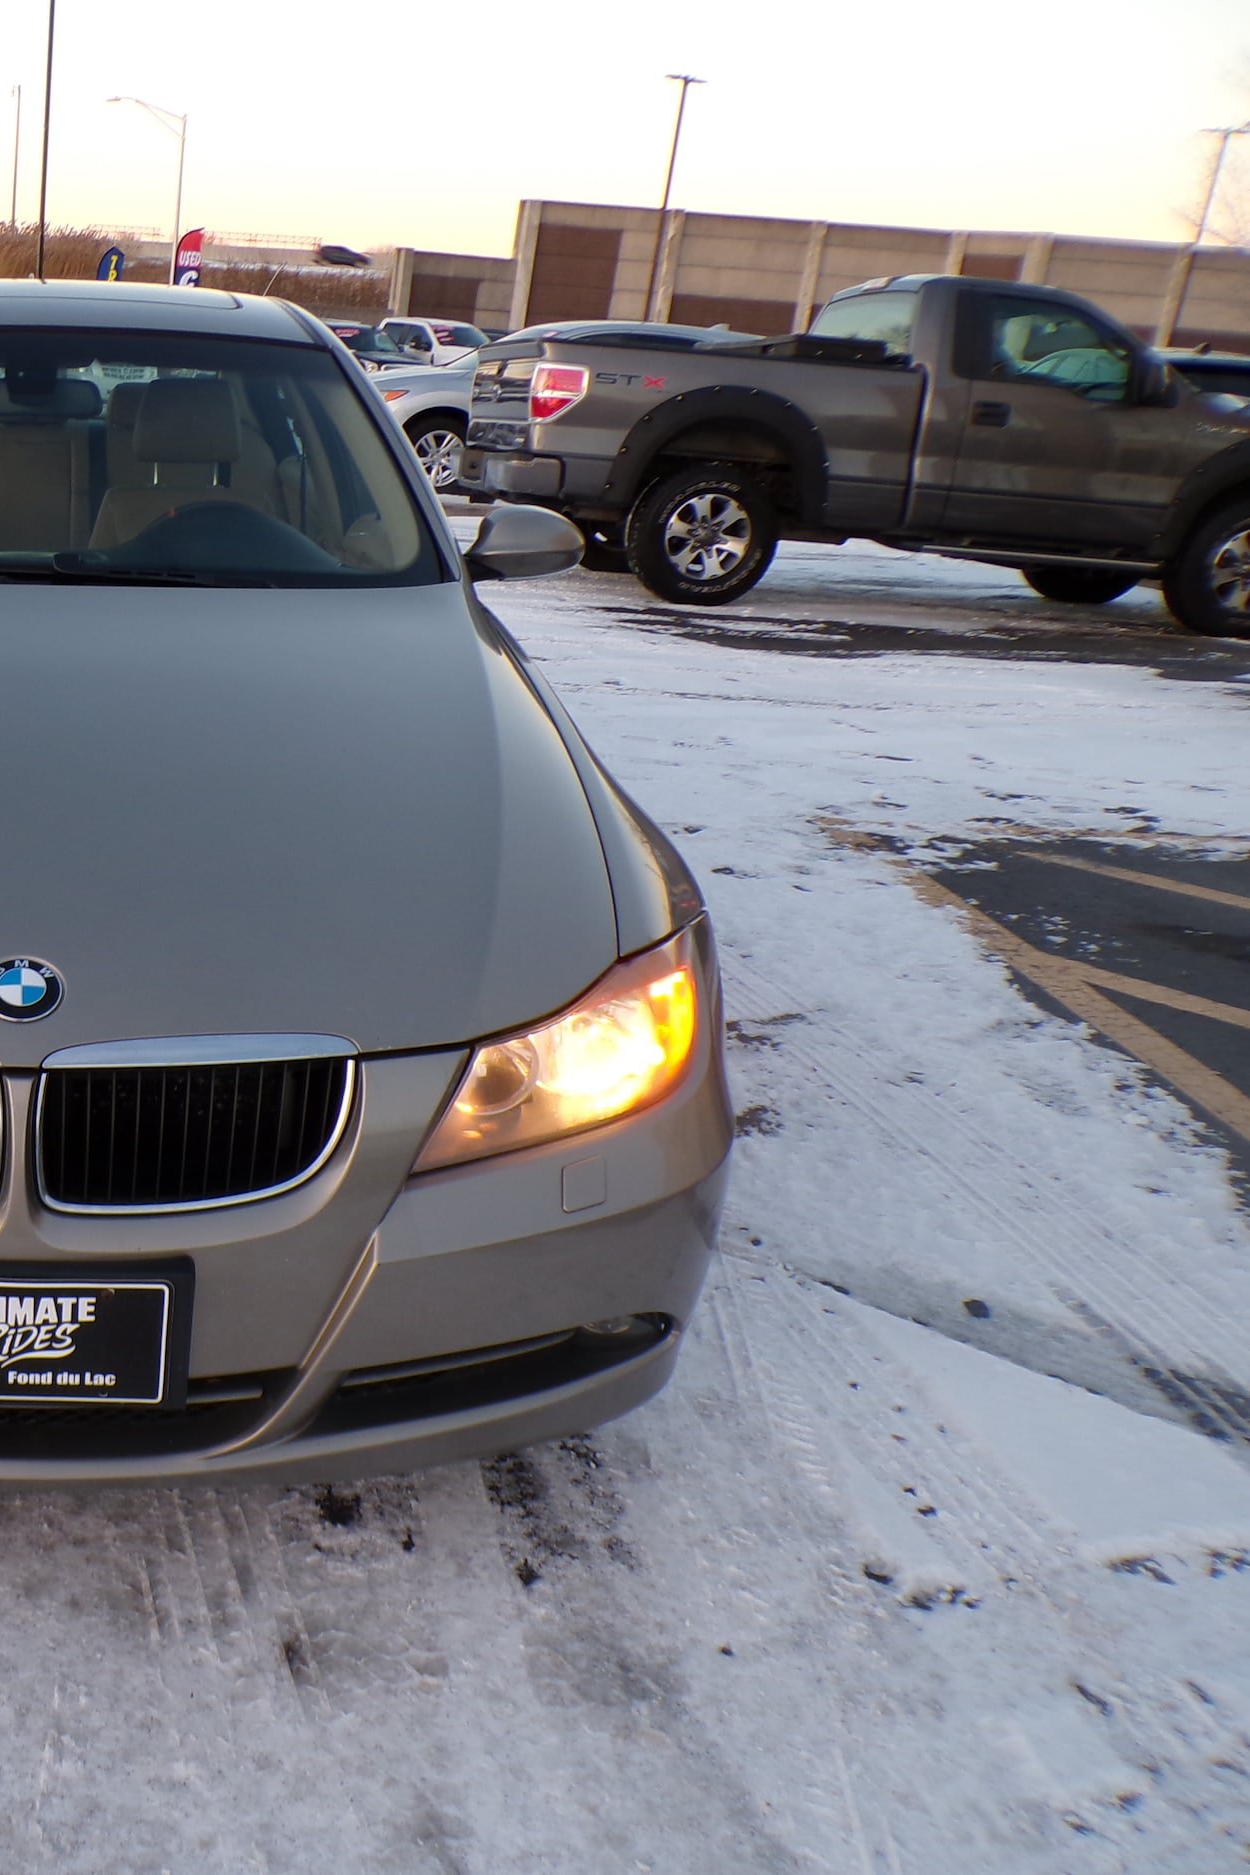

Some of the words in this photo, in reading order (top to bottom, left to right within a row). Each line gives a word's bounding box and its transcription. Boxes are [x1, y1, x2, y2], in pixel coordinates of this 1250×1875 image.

[179, 250, 202, 267] USED
[595, 372, 667, 389] STX
[7, 1370, 54, 1386] Fond
[56, 1371, 81, 1386] du
[84, 1371, 117, 1387] Lac
